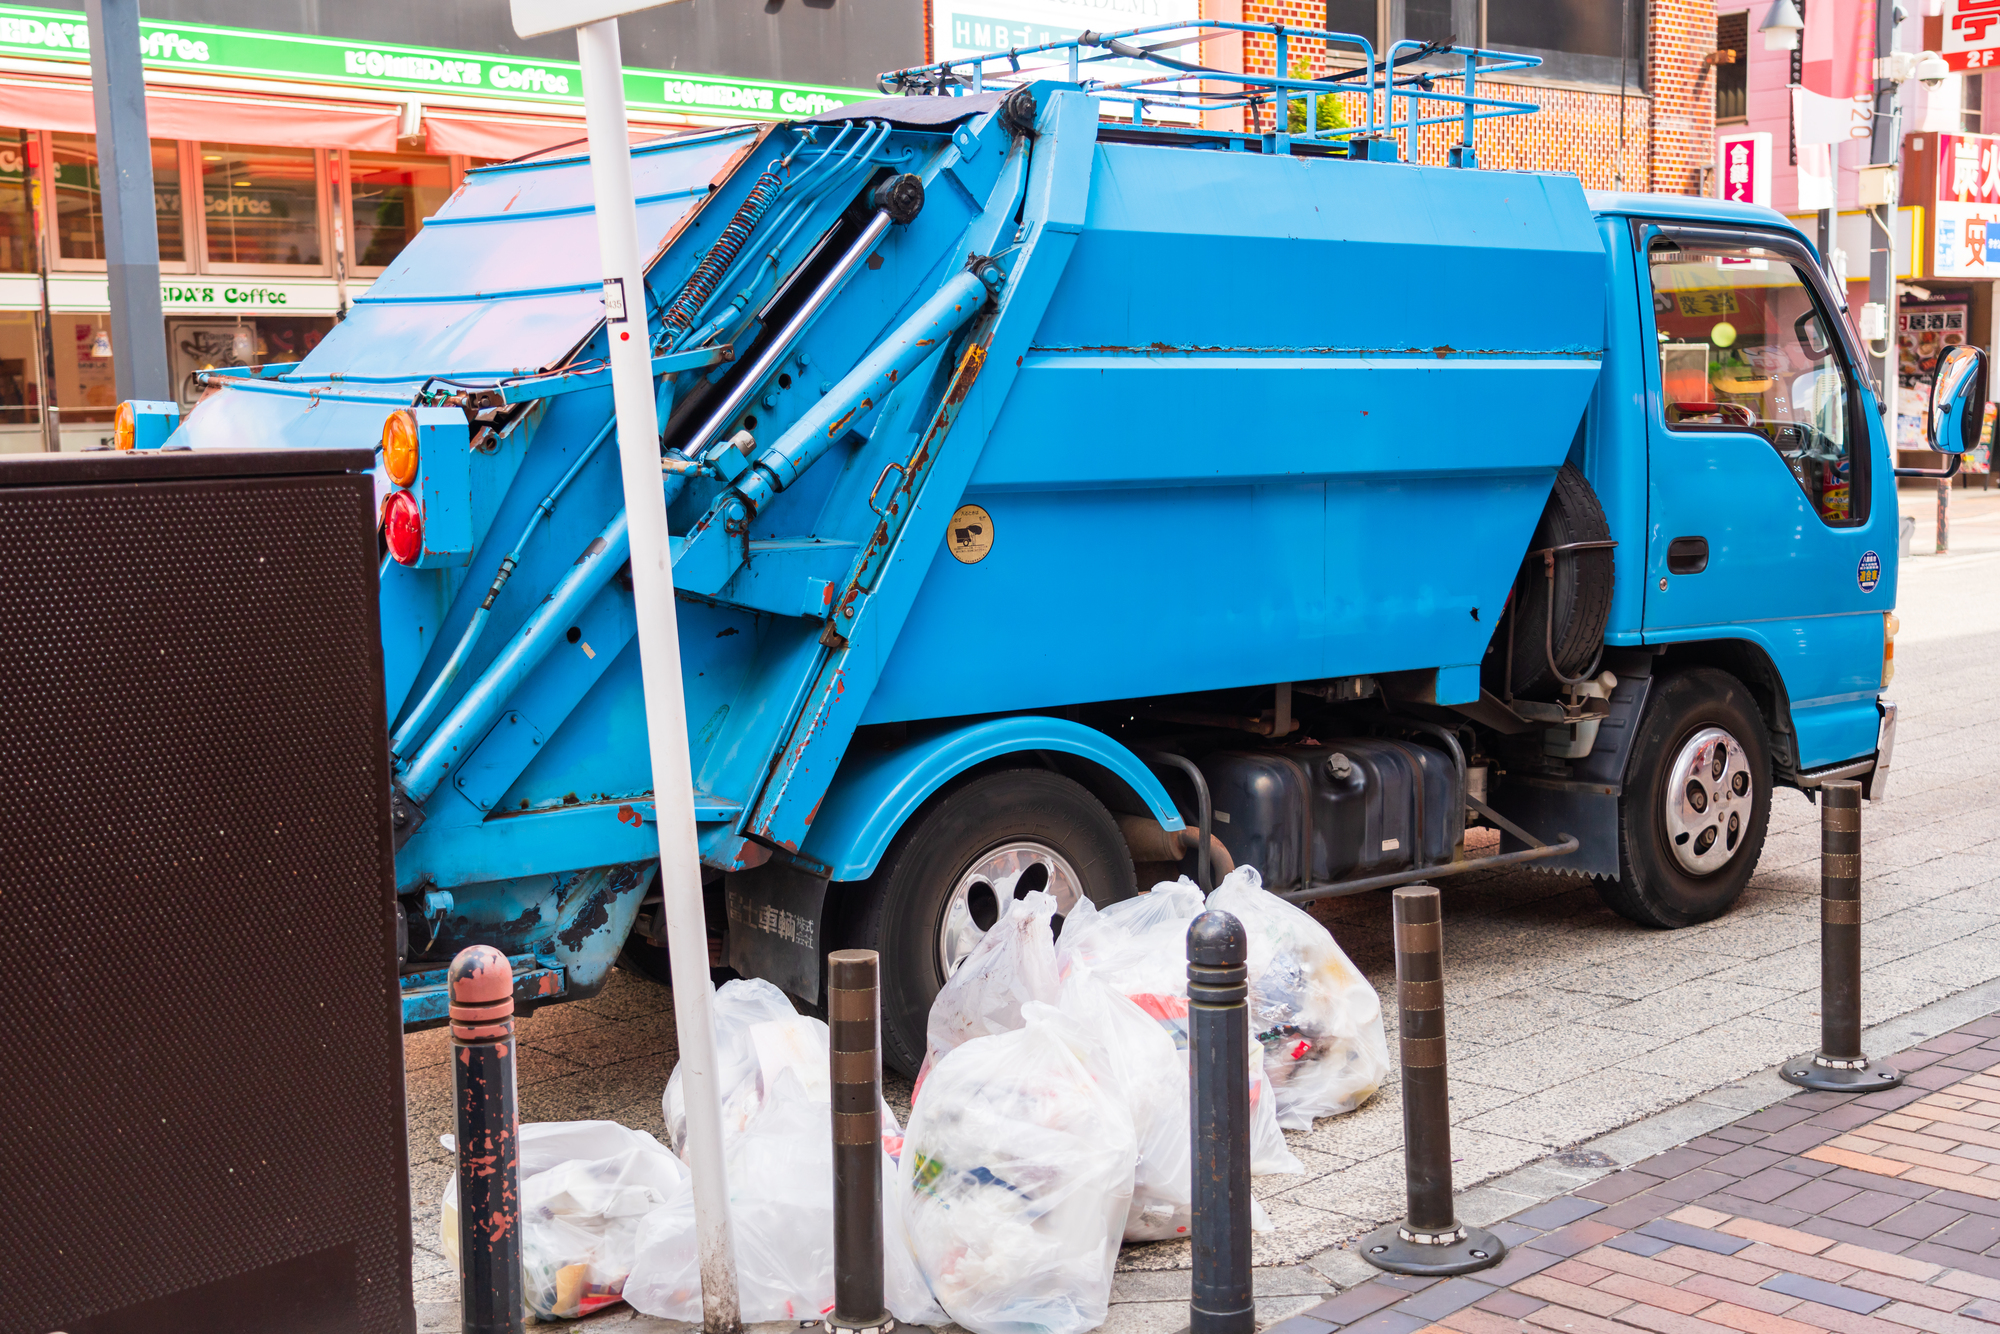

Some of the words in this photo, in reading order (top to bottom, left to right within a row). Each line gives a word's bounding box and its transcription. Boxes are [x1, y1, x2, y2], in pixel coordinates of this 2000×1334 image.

[1855, 0, 1876, 62] KYO
[344, 50, 481, 85] KOMEDA'S
[489, 65, 570, 94] Coffee
[1966, 50, 1994, 68] 2F
[664, 81, 774, 110] KOMEDA'S
[1850, 72, 1873, 139] 2020
[224, 287, 288, 304] Coffee
